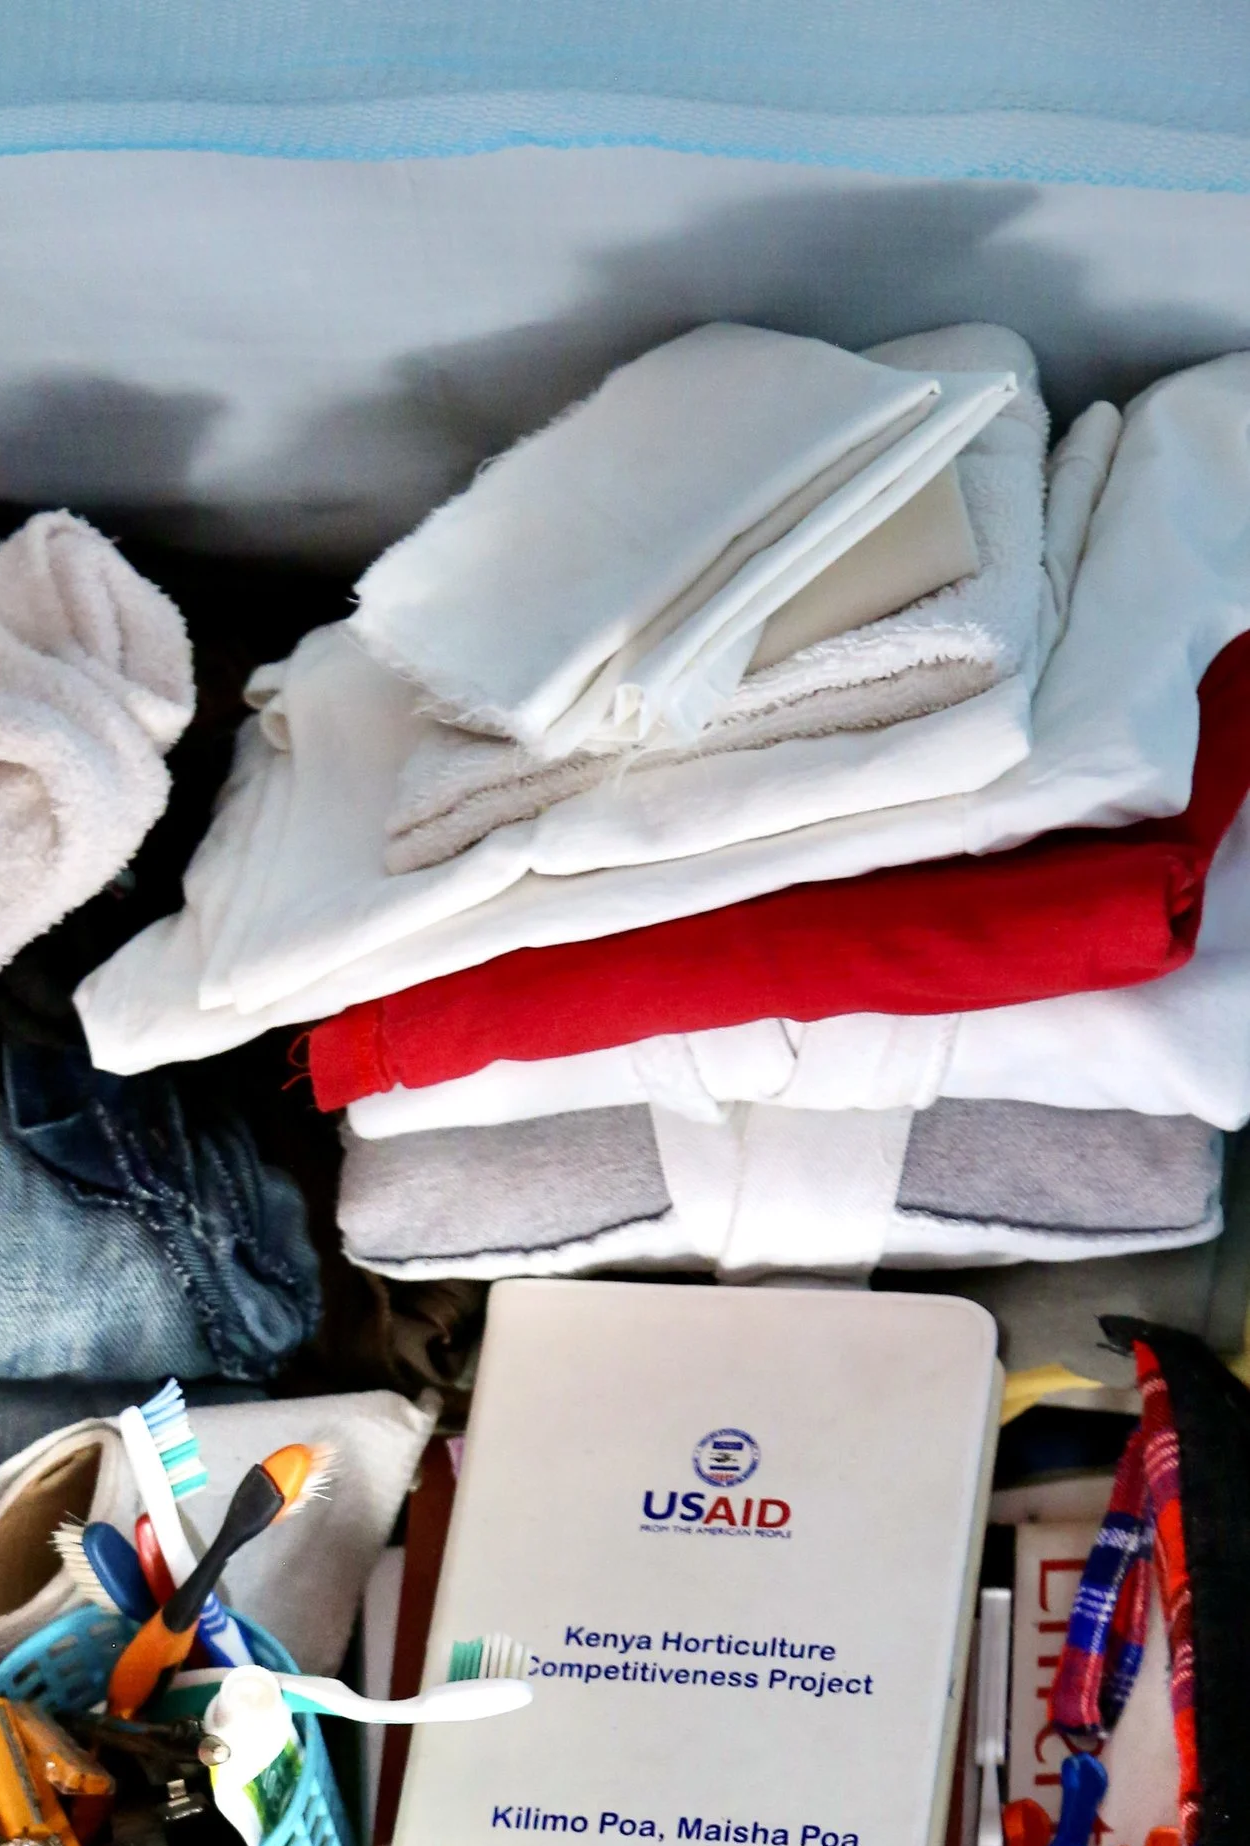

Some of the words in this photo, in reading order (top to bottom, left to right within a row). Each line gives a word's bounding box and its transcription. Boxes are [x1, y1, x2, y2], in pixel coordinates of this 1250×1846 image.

[643, 1490, 791, 1528] USAID
[640, 1524, 669, 1533] FROM
[673, 1525, 691, 1534] THE
[695, 1527, 751, 1537] AMERICAN
[754, 1529, 792, 1539] PEOPLE
[564, 1626, 652, 1654] Kenya
[662, 1631, 836, 1661] Horticulture
[768, 1669, 874, 1697] Project
[492, 1804, 589, 1834] Kilimo
[599, 1812, 665, 1841] Poa,
[677, 1816, 789, 1846] Maisha
